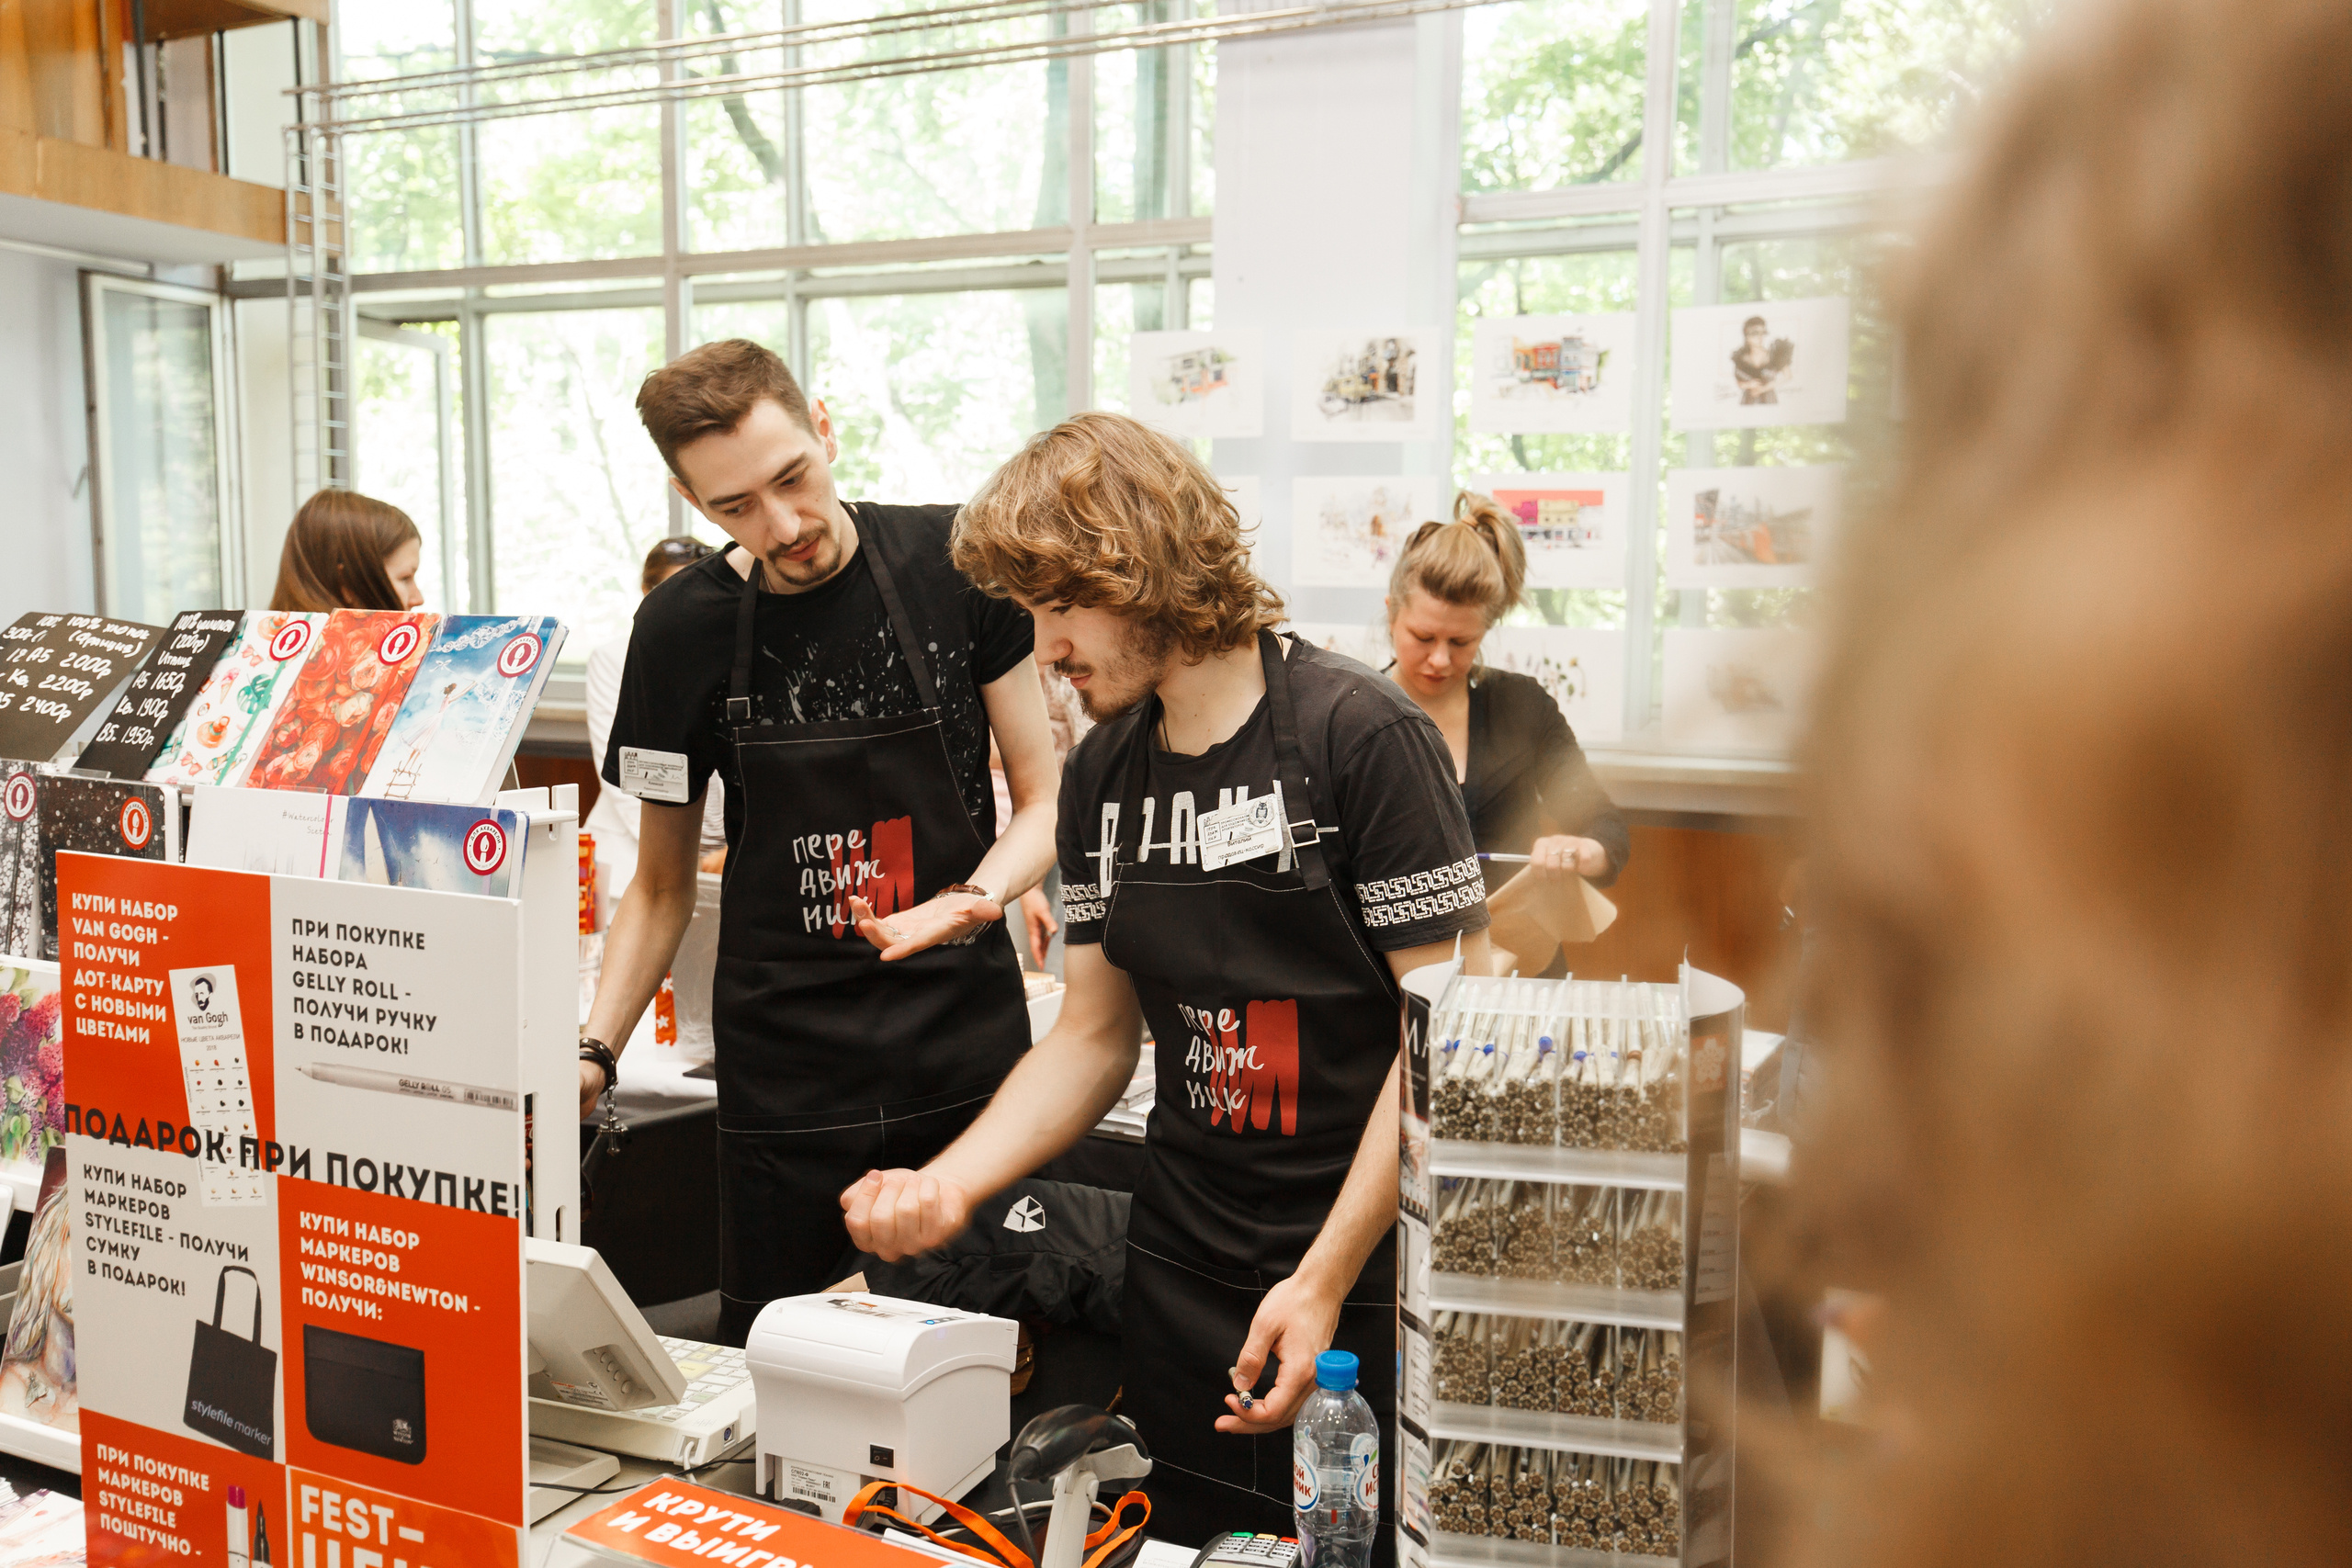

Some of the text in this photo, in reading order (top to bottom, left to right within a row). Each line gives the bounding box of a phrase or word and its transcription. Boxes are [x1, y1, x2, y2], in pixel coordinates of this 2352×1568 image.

[67, 616, 103, 629] 100%
[282, 809, 334, 823] #Watercolor
[72, 892, 178, 921] КУПИ НАБОР
[73, 918, 104, 937] VAN
[108, 921, 158, 944] GOGH
[292, 918, 425, 951] ПРИ ПОКУПКЕ
[74, 942, 140, 966] ПОЛУЧИ
[292, 944, 368, 970] НАБОРА
[74, 968, 164, 997] ДОТ-КАРТУ
[292, 971, 346, 994] GELLY
[353, 978, 399, 1000] ROLL
[91, 995, 166, 1022] НОВЫМИ
[205, 1011, 229, 1027] Gogh
[293, 997, 437, 1032] ПОЛУЧИ РУЧКУ
[76, 1017, 150, 1044] ЦВЕТАМИ
[294, 1022, 409, 1055] В ПОДАРОК!
[64, 1103, 519, 1219] ПОДАРОК ПРИ ПОКУПКЕ!
[84, 1163, 187, 1199] КУПИ НАБОР
[85, 1188, 170, 1220] МАРКЕРОВ
[85, 1212, 164, 1243] STYLEFILE
[180, 1232, 249, 1262] ПОЛУЧИ
[300, 1211, 420, 1249] КУПИ НАБОР
[85, 1236, 141, 1261] СУМКУ
[300, 1236, 401, 1272] МАРКЕРОВ
[87, 1259, 186, 1296] В ПОДАРОК!
[300, 1261, 469, 1314] WINSOR&NEWTON
[301, 1287, 383, 1320] ПОЛУЧИ:
[191, 1399, 271, 1447] stylefile marker
[96, 1443, 209, 1492] ПРИ ПОКУПКЕ
[97, 1467, 183, 1506] МАРКЕРОВ
[99, 1490, 176, 1529] STYLEFILE
[643, 1492, 782, 1541] КРУТИ
[100, 1514, 191, 1556] ПОШТУЧНО
[606, 1510, 814, 1568] И ВЫИГР
